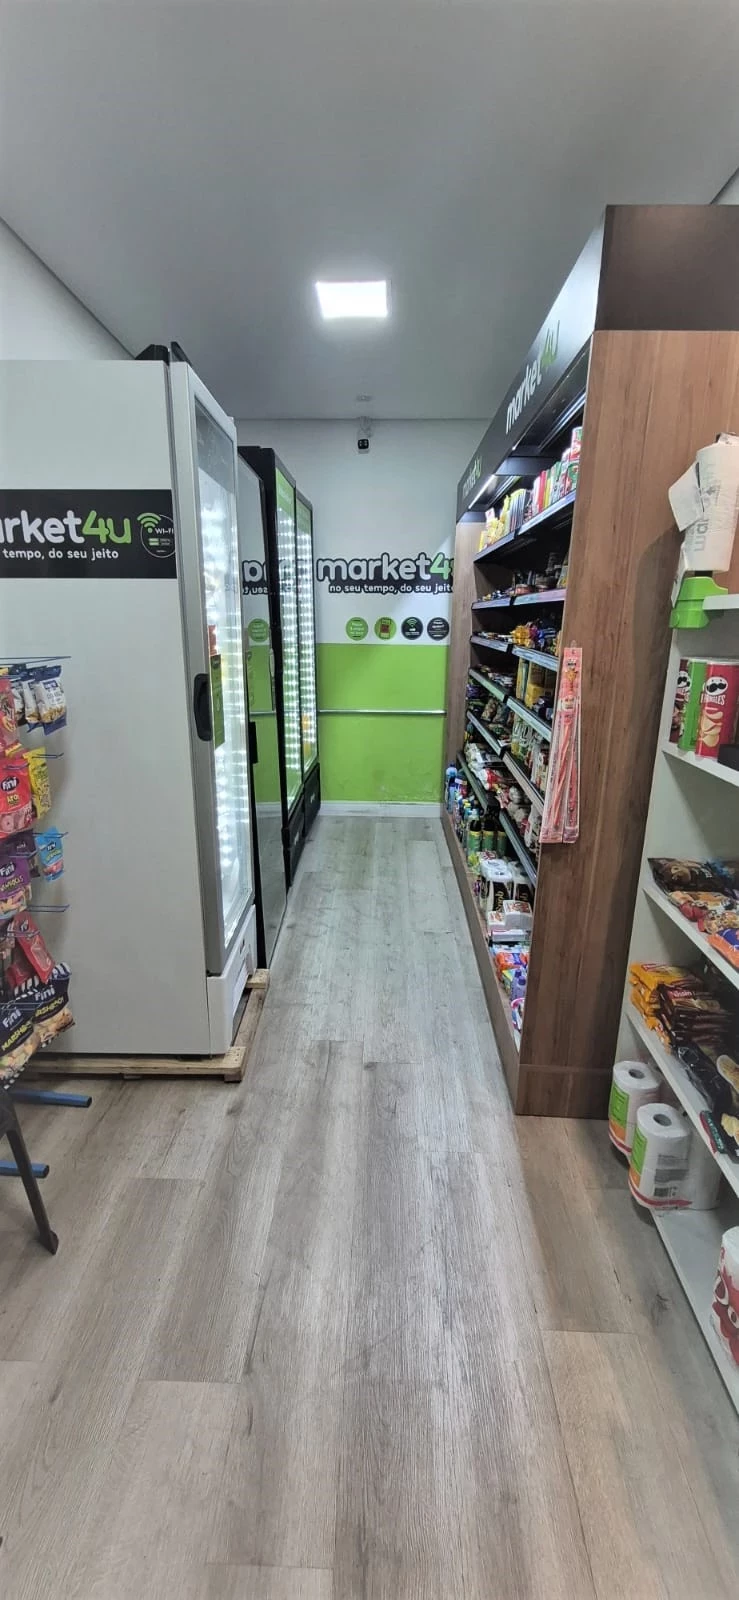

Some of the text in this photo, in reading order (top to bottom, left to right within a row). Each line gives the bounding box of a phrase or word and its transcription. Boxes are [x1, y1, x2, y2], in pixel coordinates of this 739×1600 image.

[505, 319, 561, 435] market4u
[2, 547, 119, 561] tempo, do seu jeito
[316, 552, 454, 581] market4
[363, 583, 397, 594] tempo,
[400, 583, 412, 592] do
[434, 583, 453, 594] jeit
